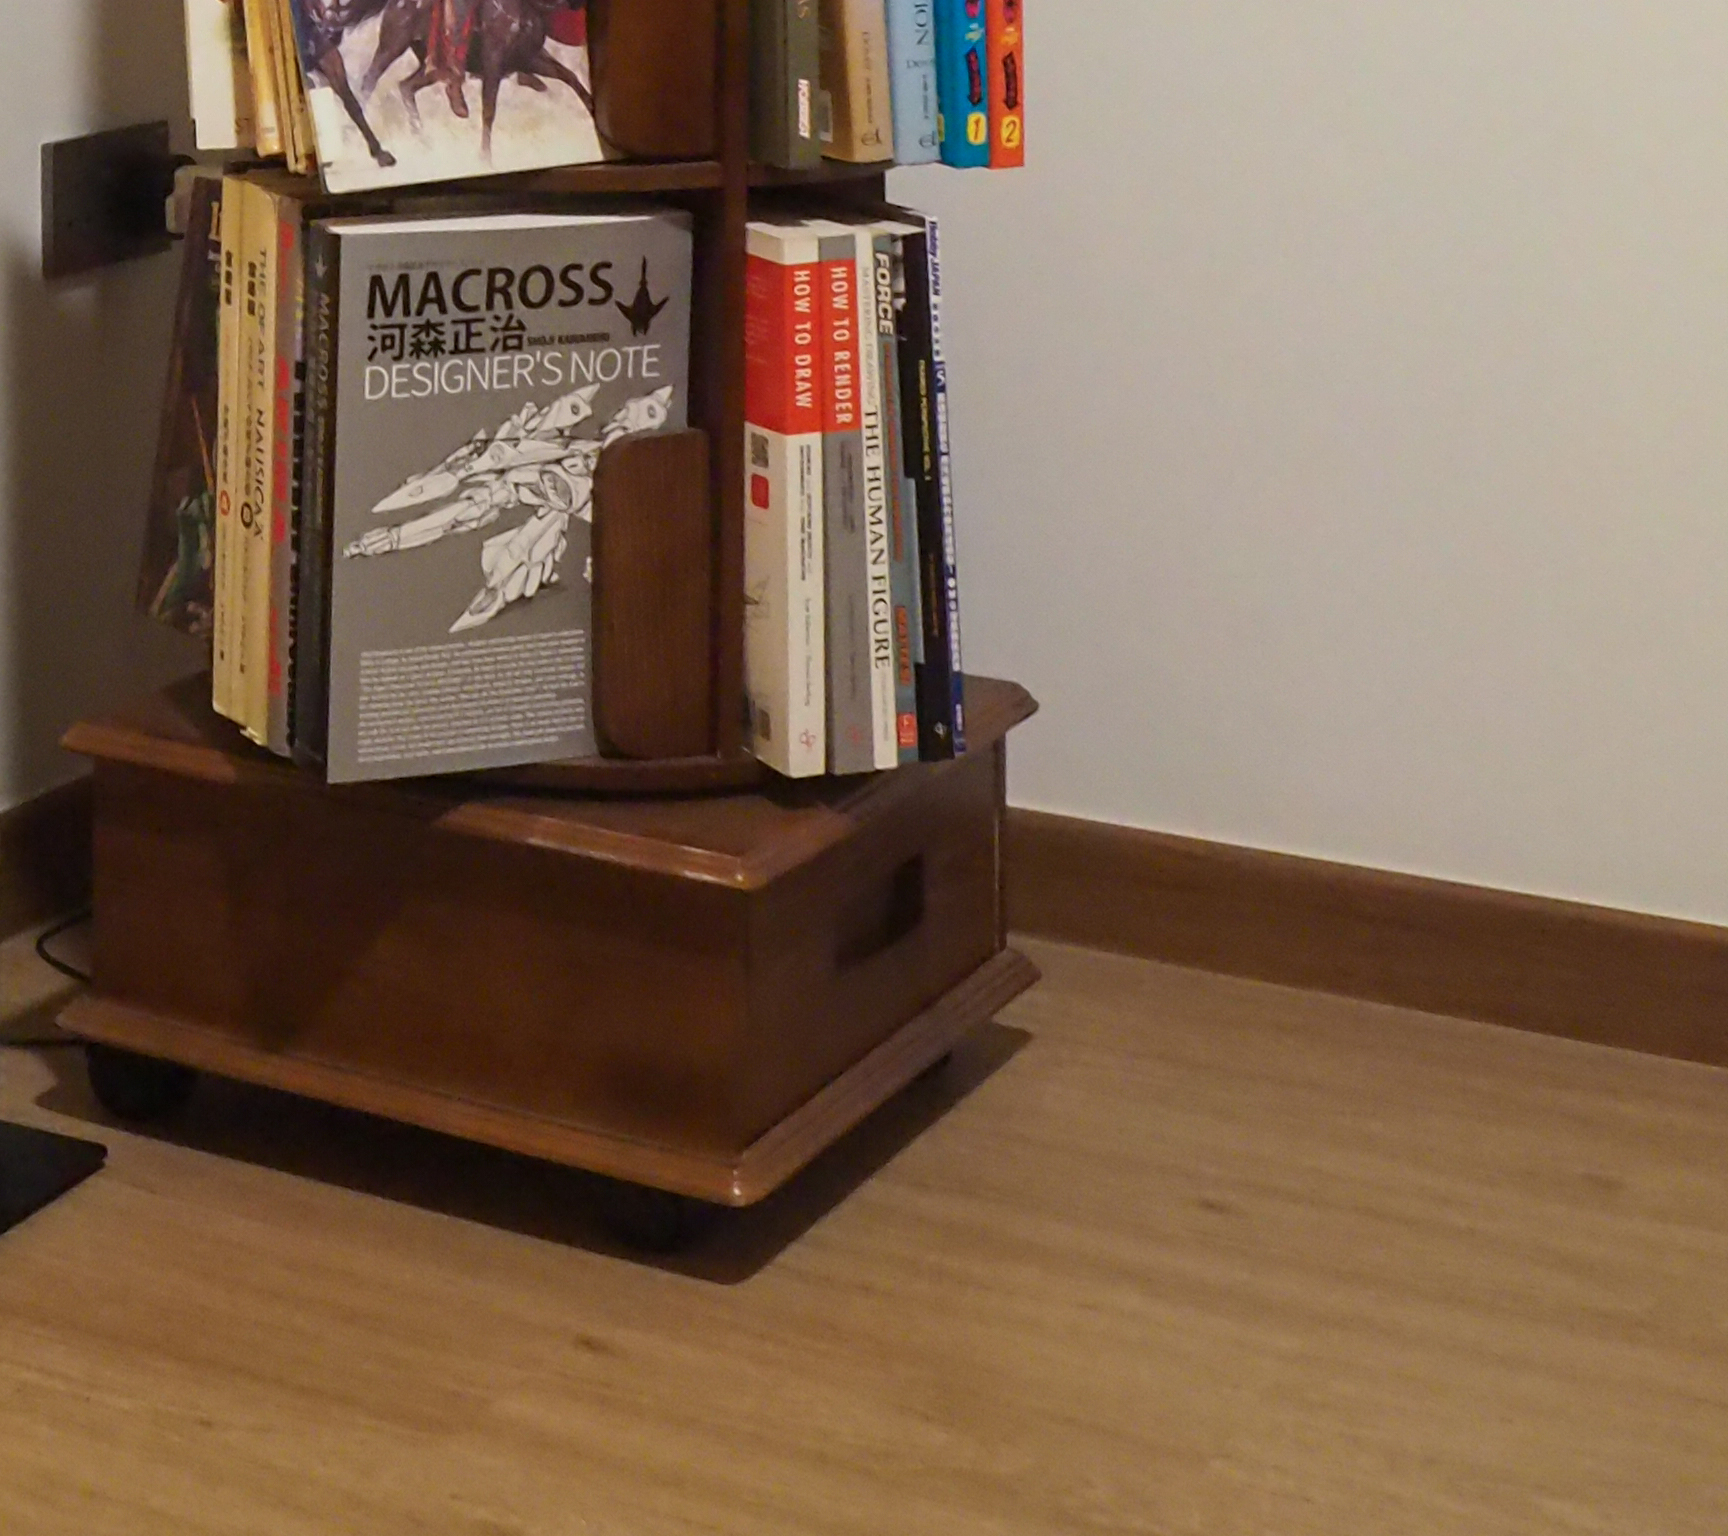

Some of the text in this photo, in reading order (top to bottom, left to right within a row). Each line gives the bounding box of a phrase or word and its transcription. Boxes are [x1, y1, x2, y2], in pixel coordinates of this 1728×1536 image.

[1005, 119, 1017, 143] 2
[258, 249, 268, 295] THE
[366, 261, 614, 319] MACROSS
[861, 266, 873, 339] MASTERING
[875, 252, 894, 335] FORCE
[255, 338, 266, 390] ART
[318, 292, 330, 410] MACROSS
[367, 314, 527, 363] 河森正治
[793, 270, 813, 409] HOW TO DRAW
[830, 266, 853, 424] HOW TO RENDER
[364, 344, 662, 401] DESIGNER'S NOTE
[865, 405, 891, 669] THE HUMAN FIGURE
